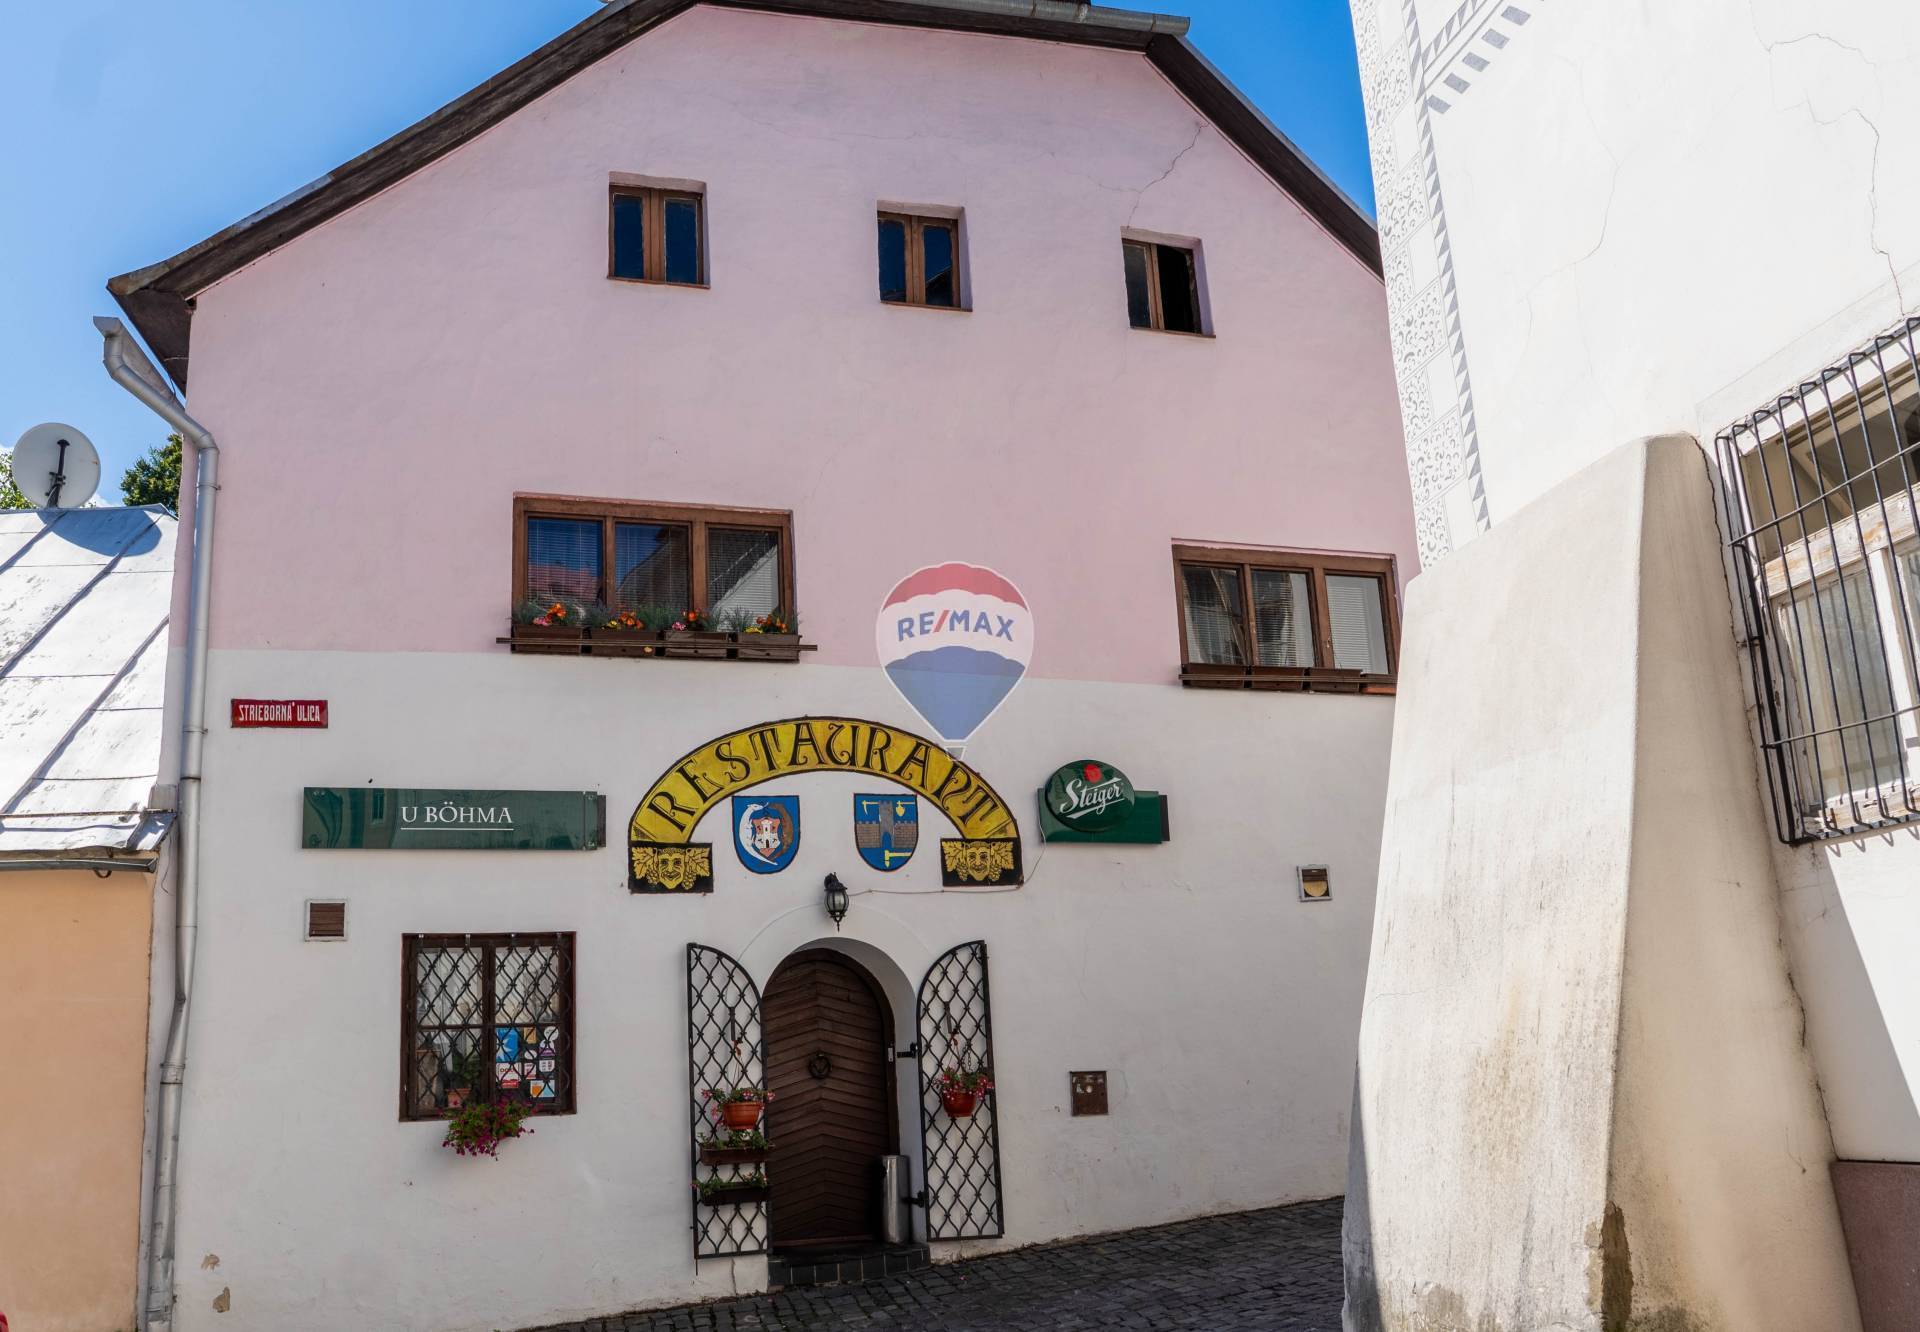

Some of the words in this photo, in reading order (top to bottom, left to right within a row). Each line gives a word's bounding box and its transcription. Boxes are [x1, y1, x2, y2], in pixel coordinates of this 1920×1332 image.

[239, 702, 295, 721] STRIEBORNÁ
[297, 705, 320, 721] ULICA
[648, 722, 999, 832] RESTAURANT
[1060, 778, 1121, 814] Steiger
[401, 806, 418, 823] U
[424, 801, 514, 823] BÖHMA
